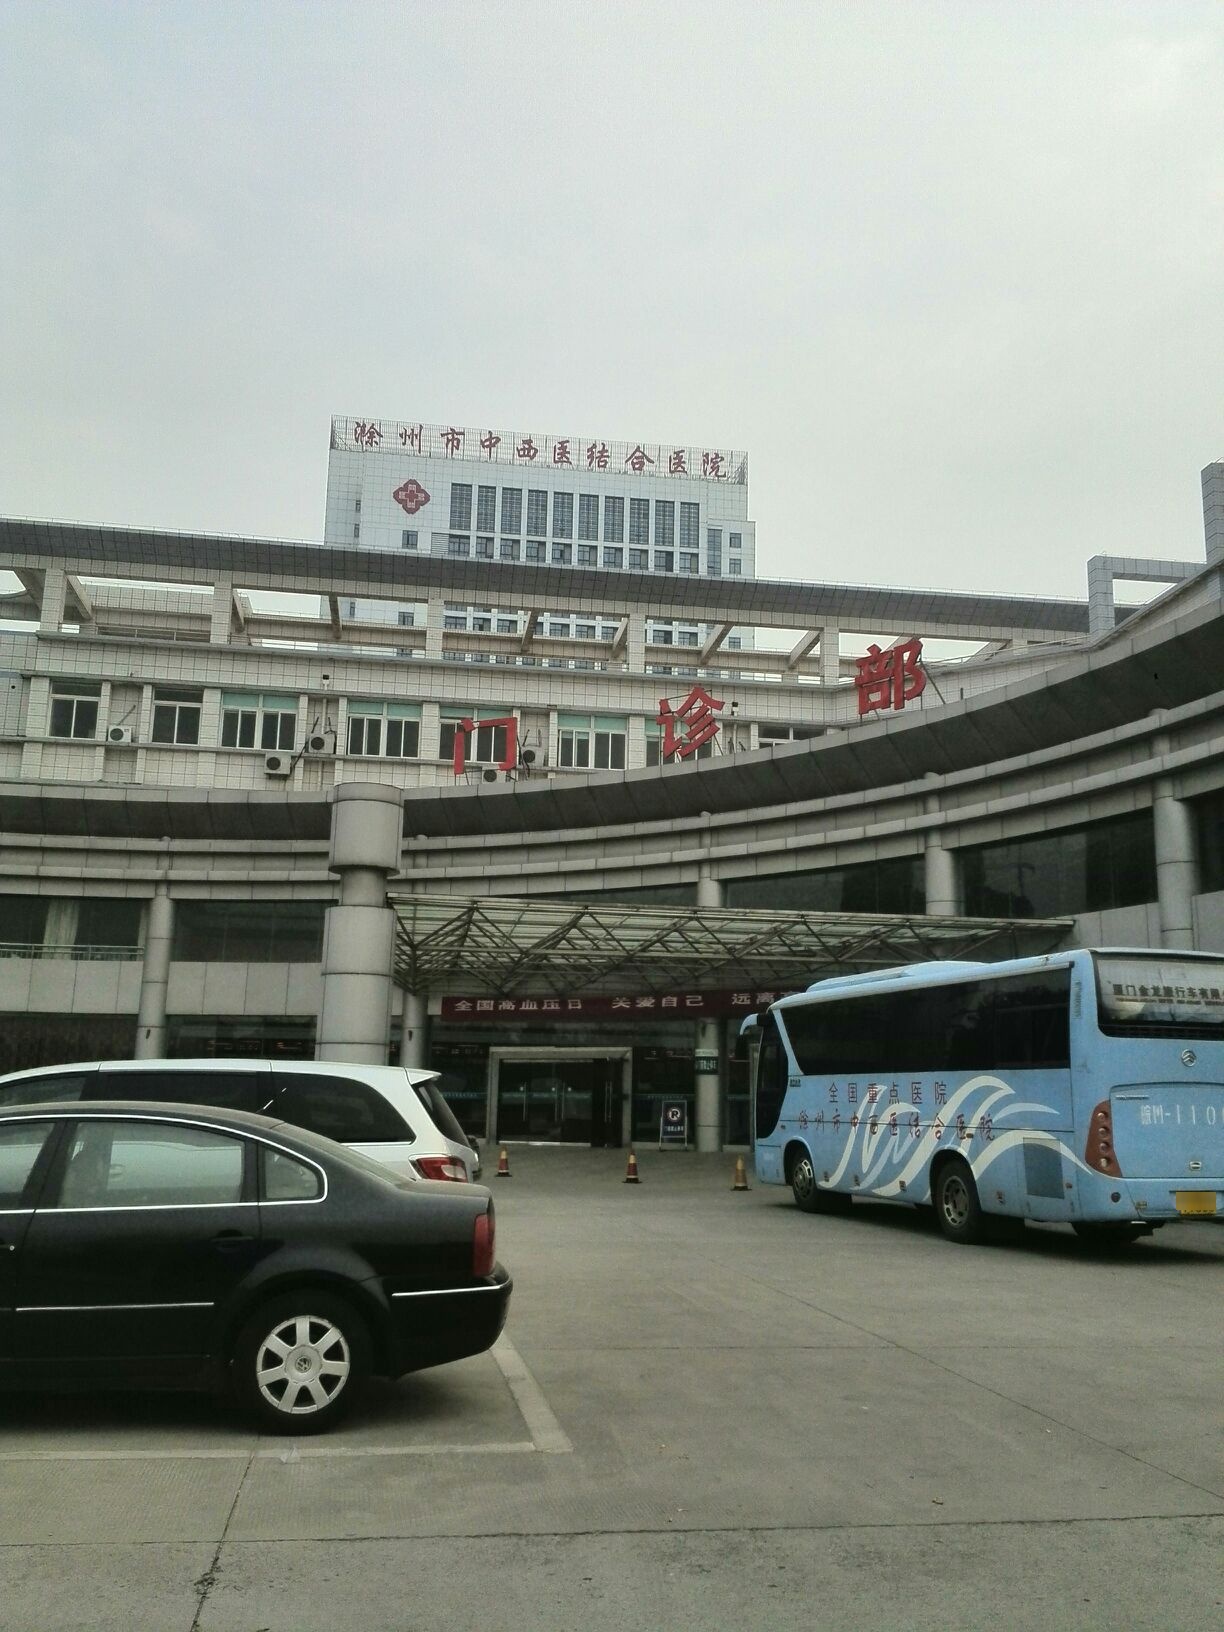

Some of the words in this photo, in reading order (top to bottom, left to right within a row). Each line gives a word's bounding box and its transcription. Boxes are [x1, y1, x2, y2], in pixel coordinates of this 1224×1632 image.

[353, 420, 730, 479] 滁州市中西医结合医院
[454, 998, 583, 1012] 全国高血压日
[611, 994, 705, 1009] 关爱自己
[731, 991, 788, 1006] 远离
[1112, 983, 1224, 1001] 厦门金龙旅行车有限
[828, 1081, 948, 1105] 全国重点医院
[1140, 1103, 1224, 1126] 皖M-110
